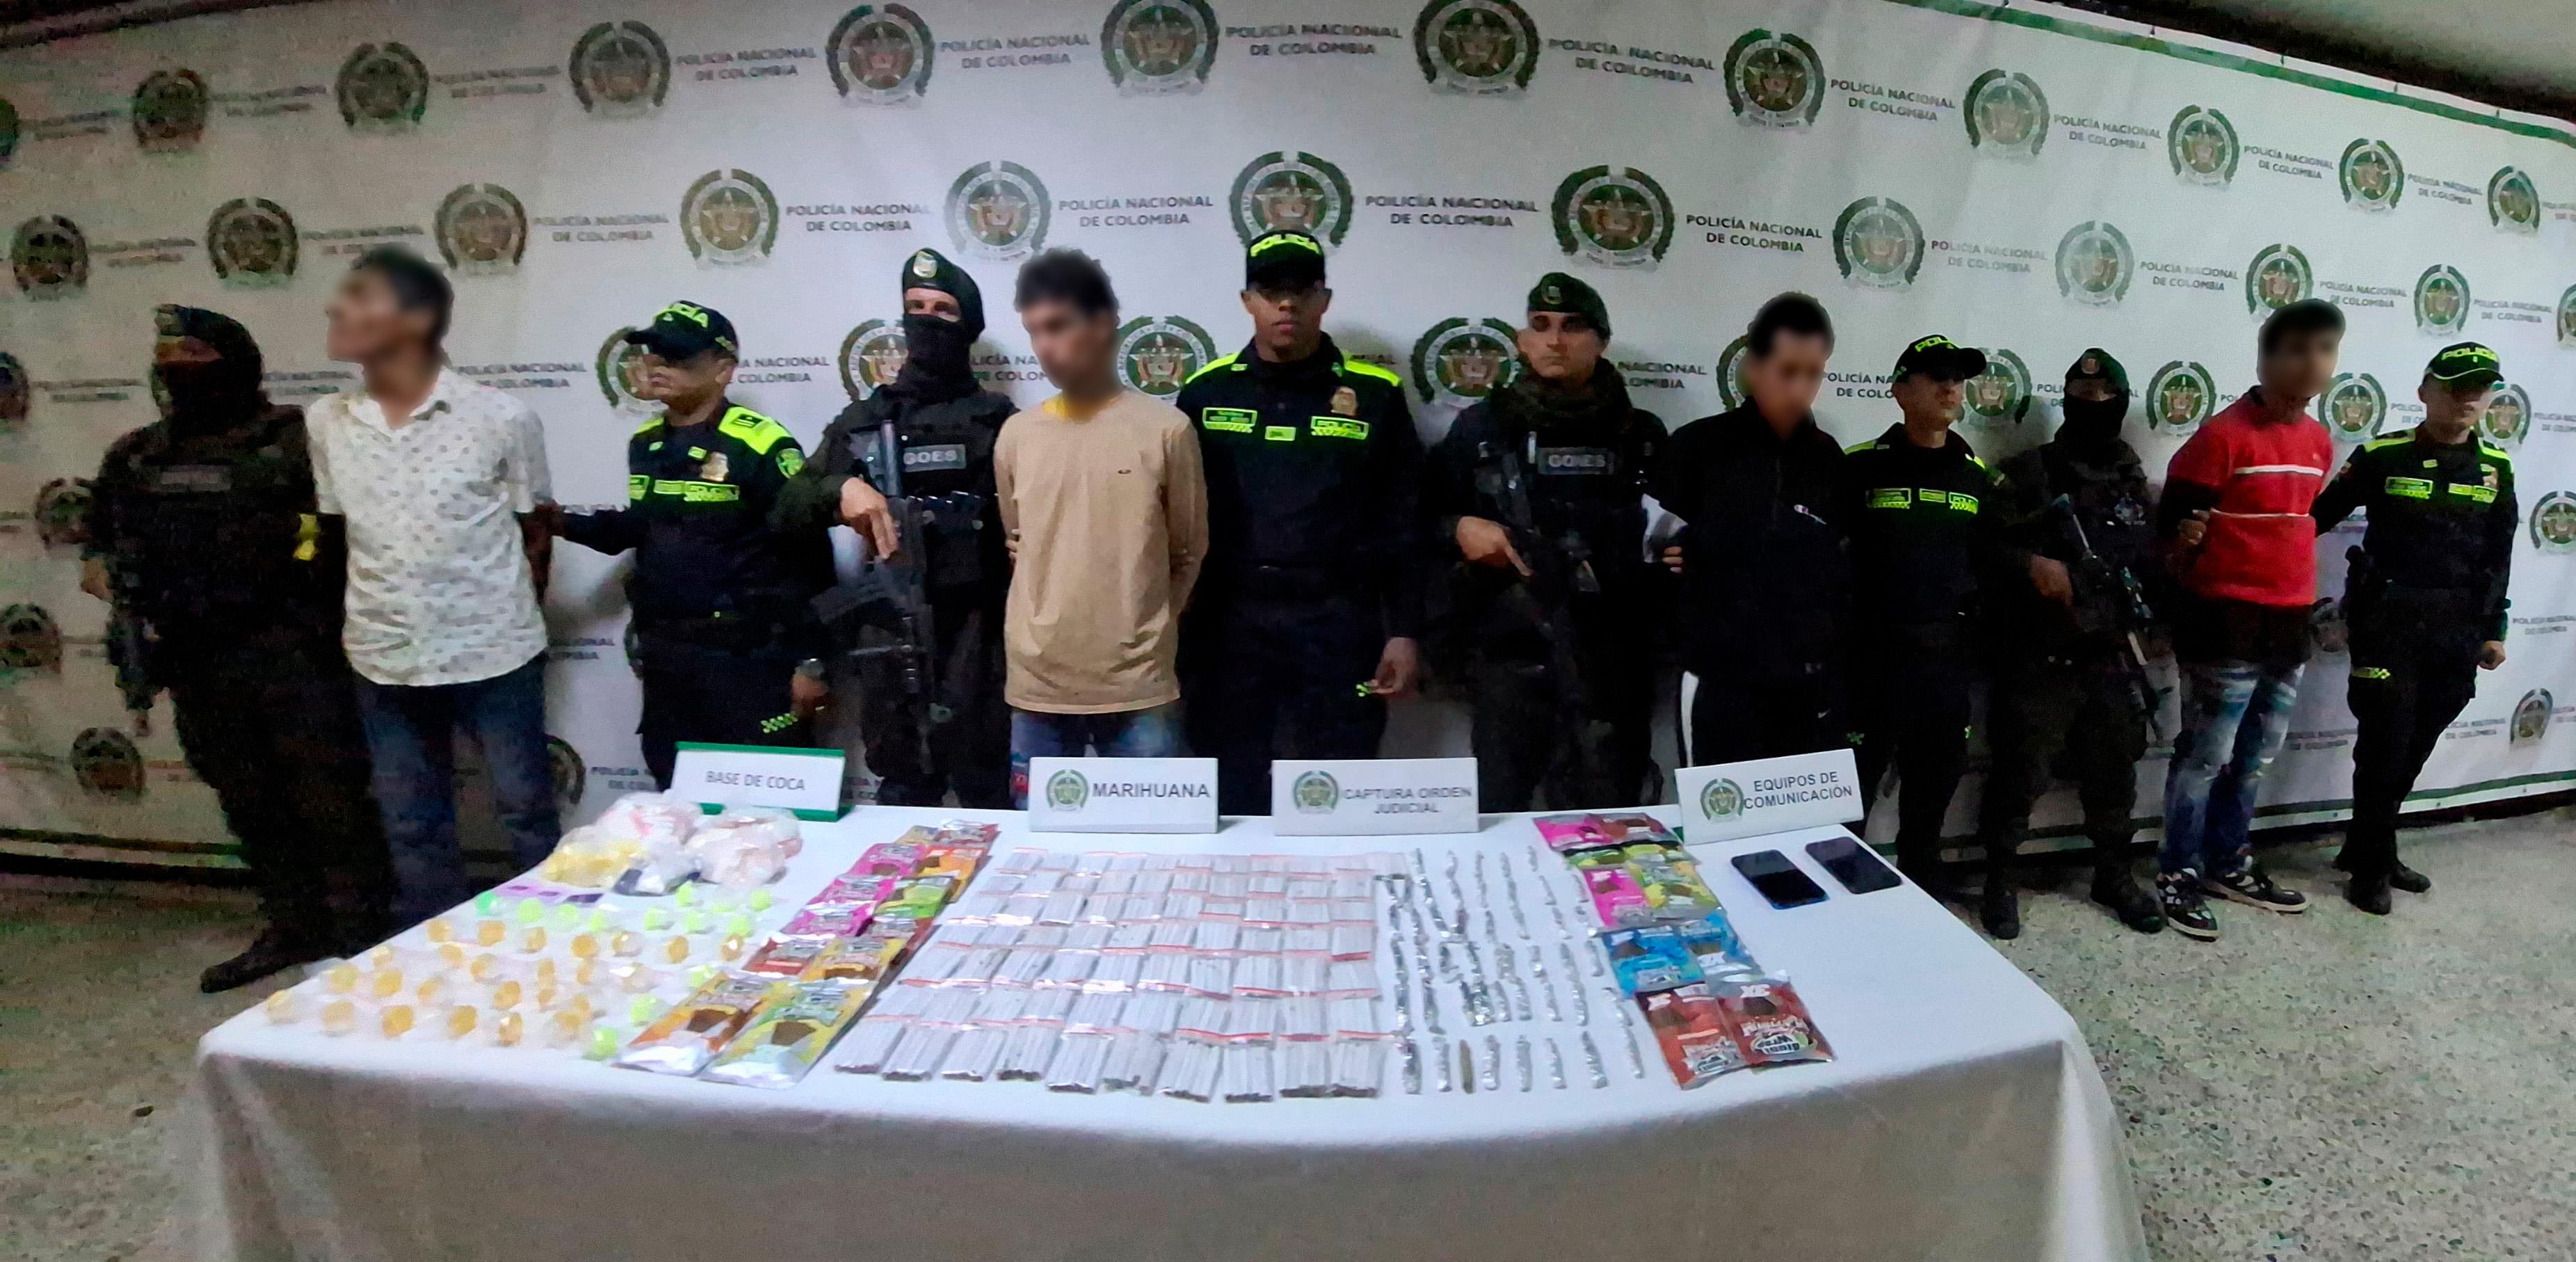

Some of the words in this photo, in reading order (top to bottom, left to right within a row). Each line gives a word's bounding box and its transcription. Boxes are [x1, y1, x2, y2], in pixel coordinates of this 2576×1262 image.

[1250, 45, 1269, 56] DE
[1575, 57, 1597, 70] DE
[1887, 88, 1956, 109] NACIONAL
[1848, 96, 1864, 109] DE
[1869, 98, 1938, 121] COLOMBIA
[1126, 196, 1214, 208] NACIONAL
[1442, 198, 1539, 212] NACIONAL
[851, 203, 930, 215] NACIONAL
[806, 221, 825, 232] DE
[830, 220, 912, 231] COLOMBIA
[1079, 216, 1100, 227] DE
[1104, 213, 1190, 226] COLOMBIA
[1390, 213, 1412, 224] DE
[1419, 213, 1513, 226] COLOMBIA
[1686, 214, 1746, 230] POLICÍA
[1748, 221, 1823, 239] NACIONAL
[1705, 232, 1725, 243] DE
[1729, 234, 1804, 253] COLOMBIA
[755, 357, 830, 367] NACIONAL
[737, 373, 812, 383] COLOMBIA
[1827, 372, 1871, 384] OLICÍA
[1836, 388, 1853, 397] DE
[706, 770, 741, 785] BASE
[744, 774, 764, 787] DE
[766, 776, 806, 790] COCA
[1753, 775, 1817, 792] EQUIPOS
[1819, 771, 1839, 784] DE
[1093, 783, 1210, 799] MARIHUANA
[1343, 788, 1415, 800] CAPTURA
[1419, 786, 1472, 799] ORDEN
[1374, 802, 1440, 814] JUDICIAL
